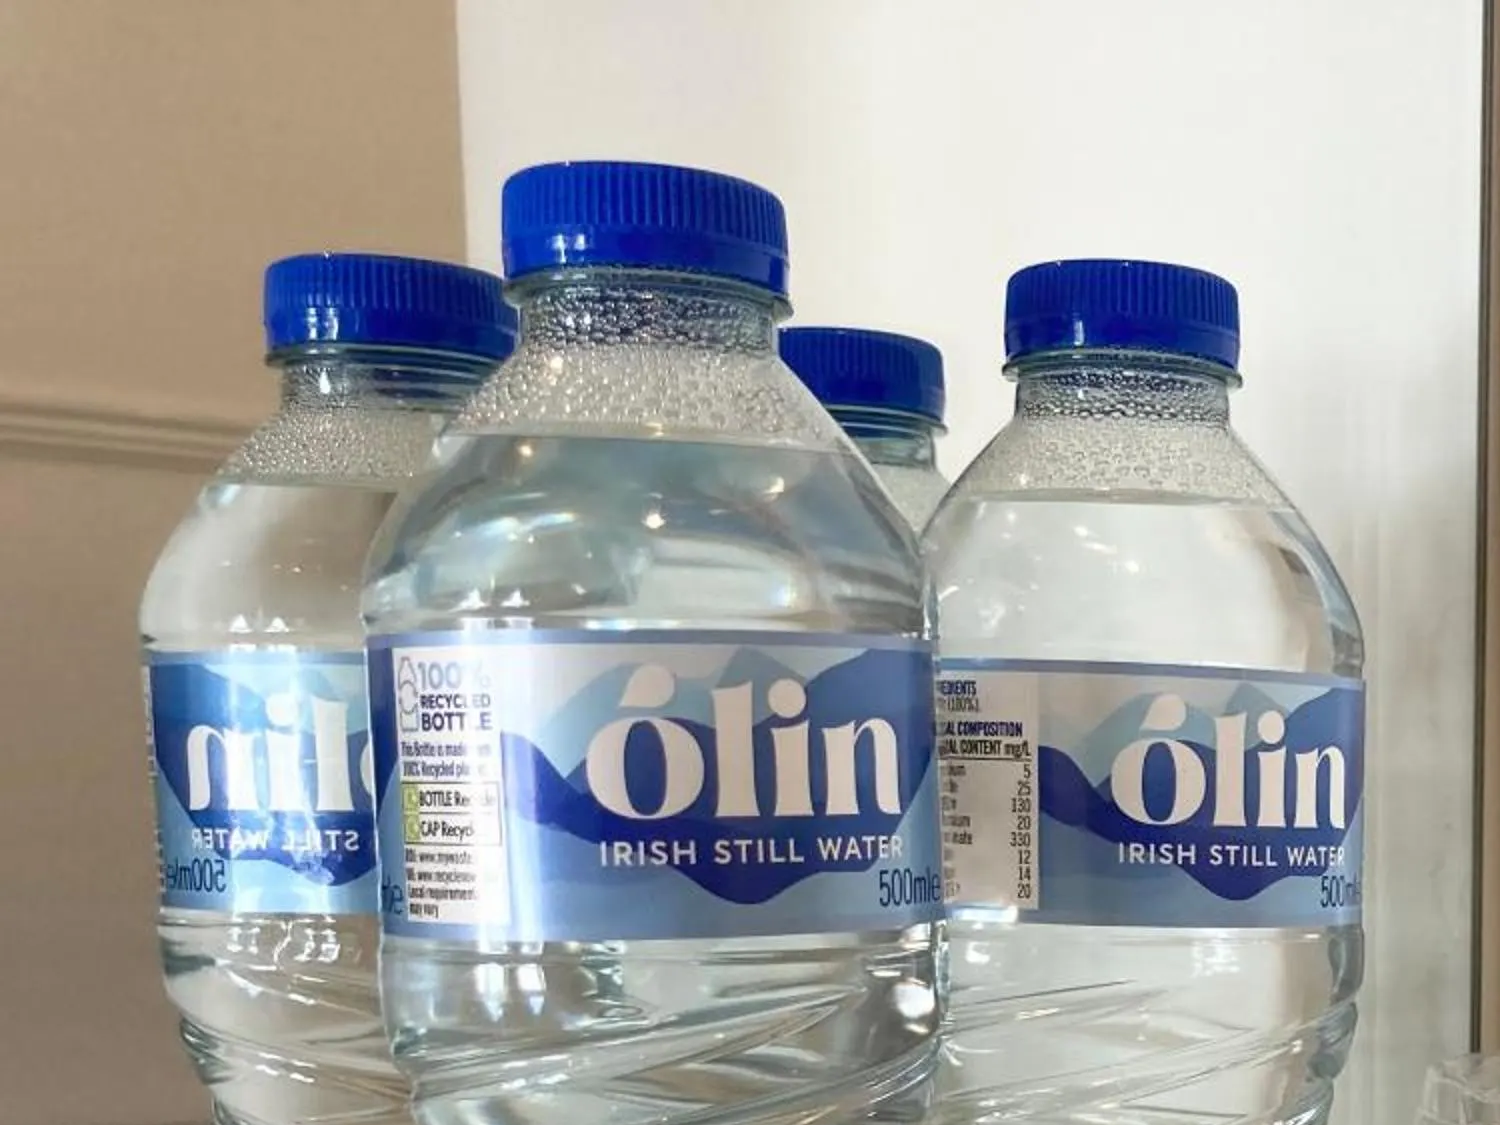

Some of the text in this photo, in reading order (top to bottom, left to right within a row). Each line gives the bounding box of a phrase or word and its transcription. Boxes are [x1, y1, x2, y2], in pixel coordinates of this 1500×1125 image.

[957, 721, 1023, 737] COMPOSITION
[586, 664, 902, 820] ólin
[960, 739, 1001, 756] CONTENT
[1111, 693, 1346, 828] ólin
[1023, 763, 1032, 779] 5
[1017, 780, 1032, 797] 25
[419, 789, 453, 807] BOTTLE
[1011, 797, 1032, 814] 130
[421, 820, 440, 838] CAP
[1017, 815, 1032, 831] 20
[1010, 831, 1032, 847] 330
[600, 835, 904, 867] IRISH STILL WATER
[1018, 849, 1032, 865] 12
[1118, 841, 1346, 868] IRISH STILL WATER
[1018, 866, 1032, 881] 14
[1017, 883, 1032, 899] 20
